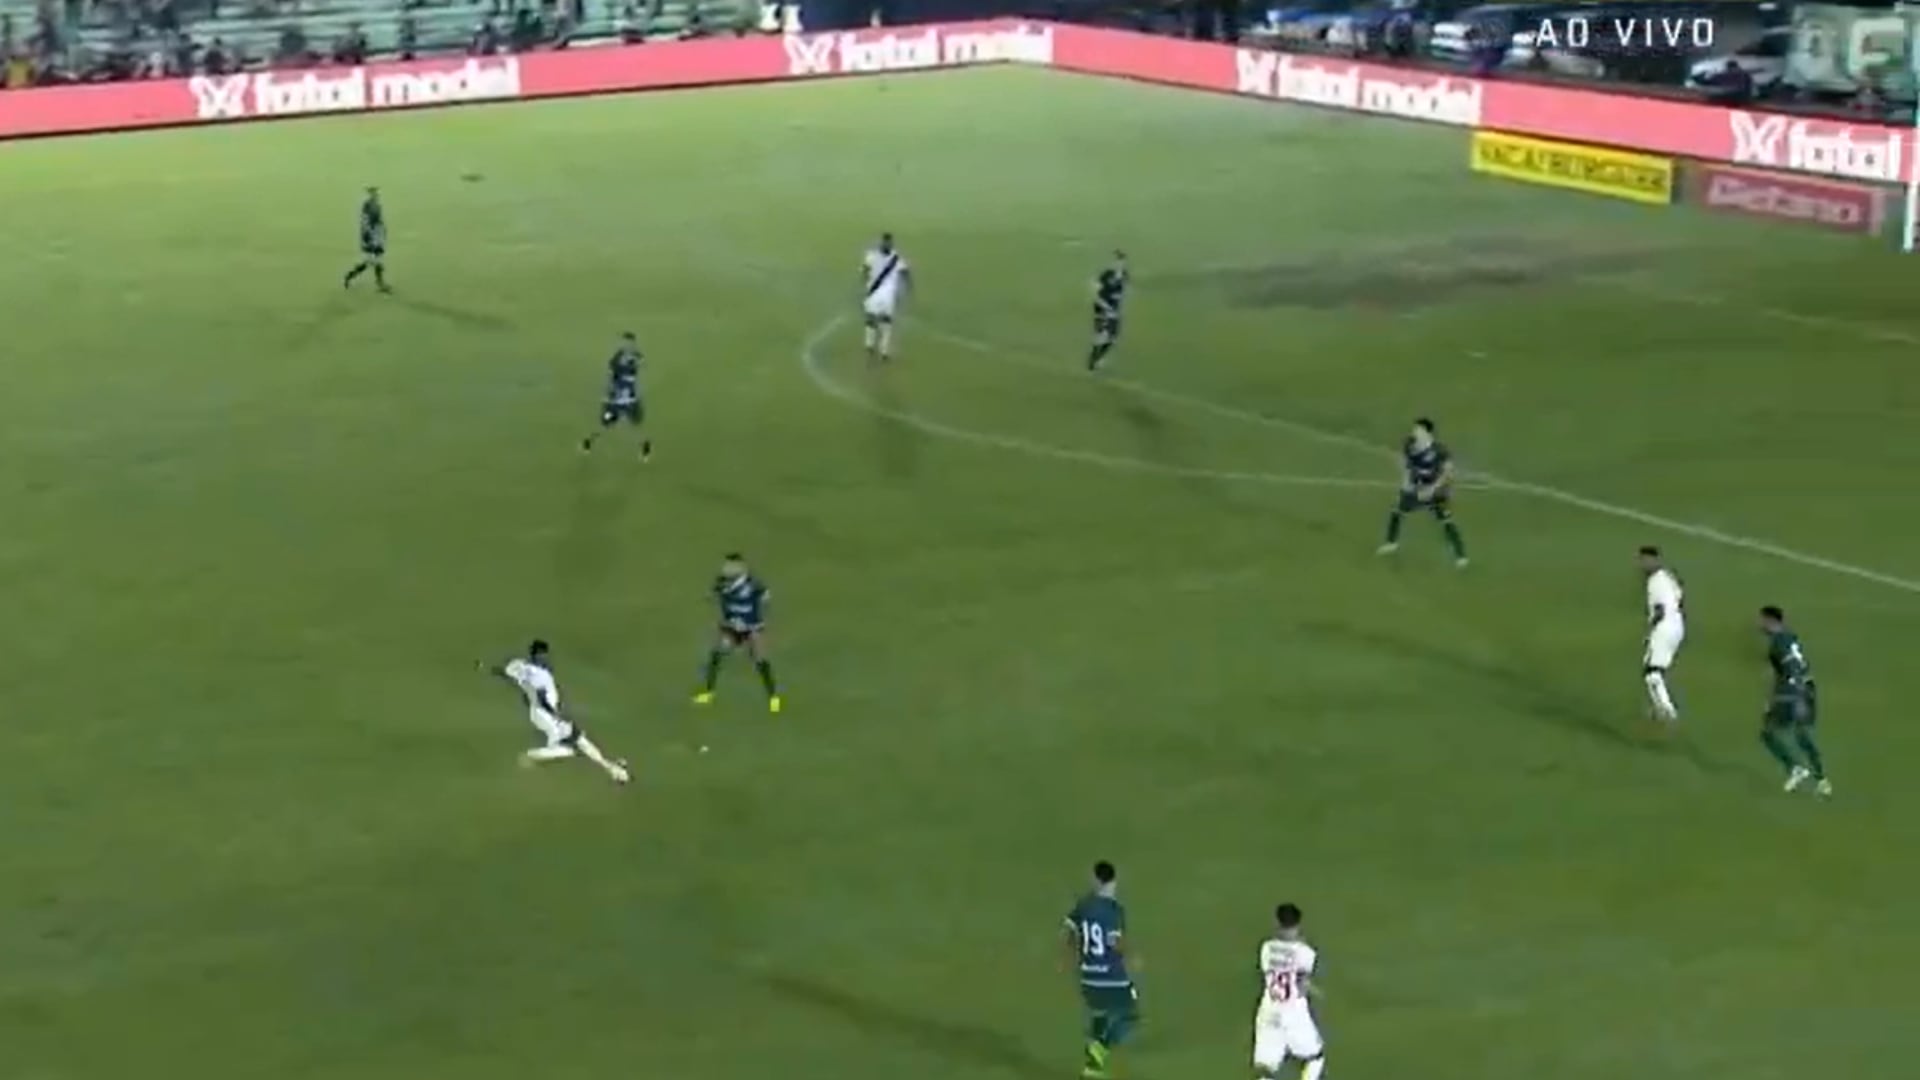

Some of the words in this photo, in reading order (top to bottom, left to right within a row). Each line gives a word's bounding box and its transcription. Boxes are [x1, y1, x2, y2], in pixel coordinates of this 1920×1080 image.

[842, 28, 939, 71] fatal
[256, 68, 365, 113] fatal
[372, 56, 521, 108] model
[1277, 54, 1359, 108] fatal
[1363, 77, 1482, 125] model
[1788, 121, 1902, 181] fatal
[1081, 920, 1105, 955] 19
